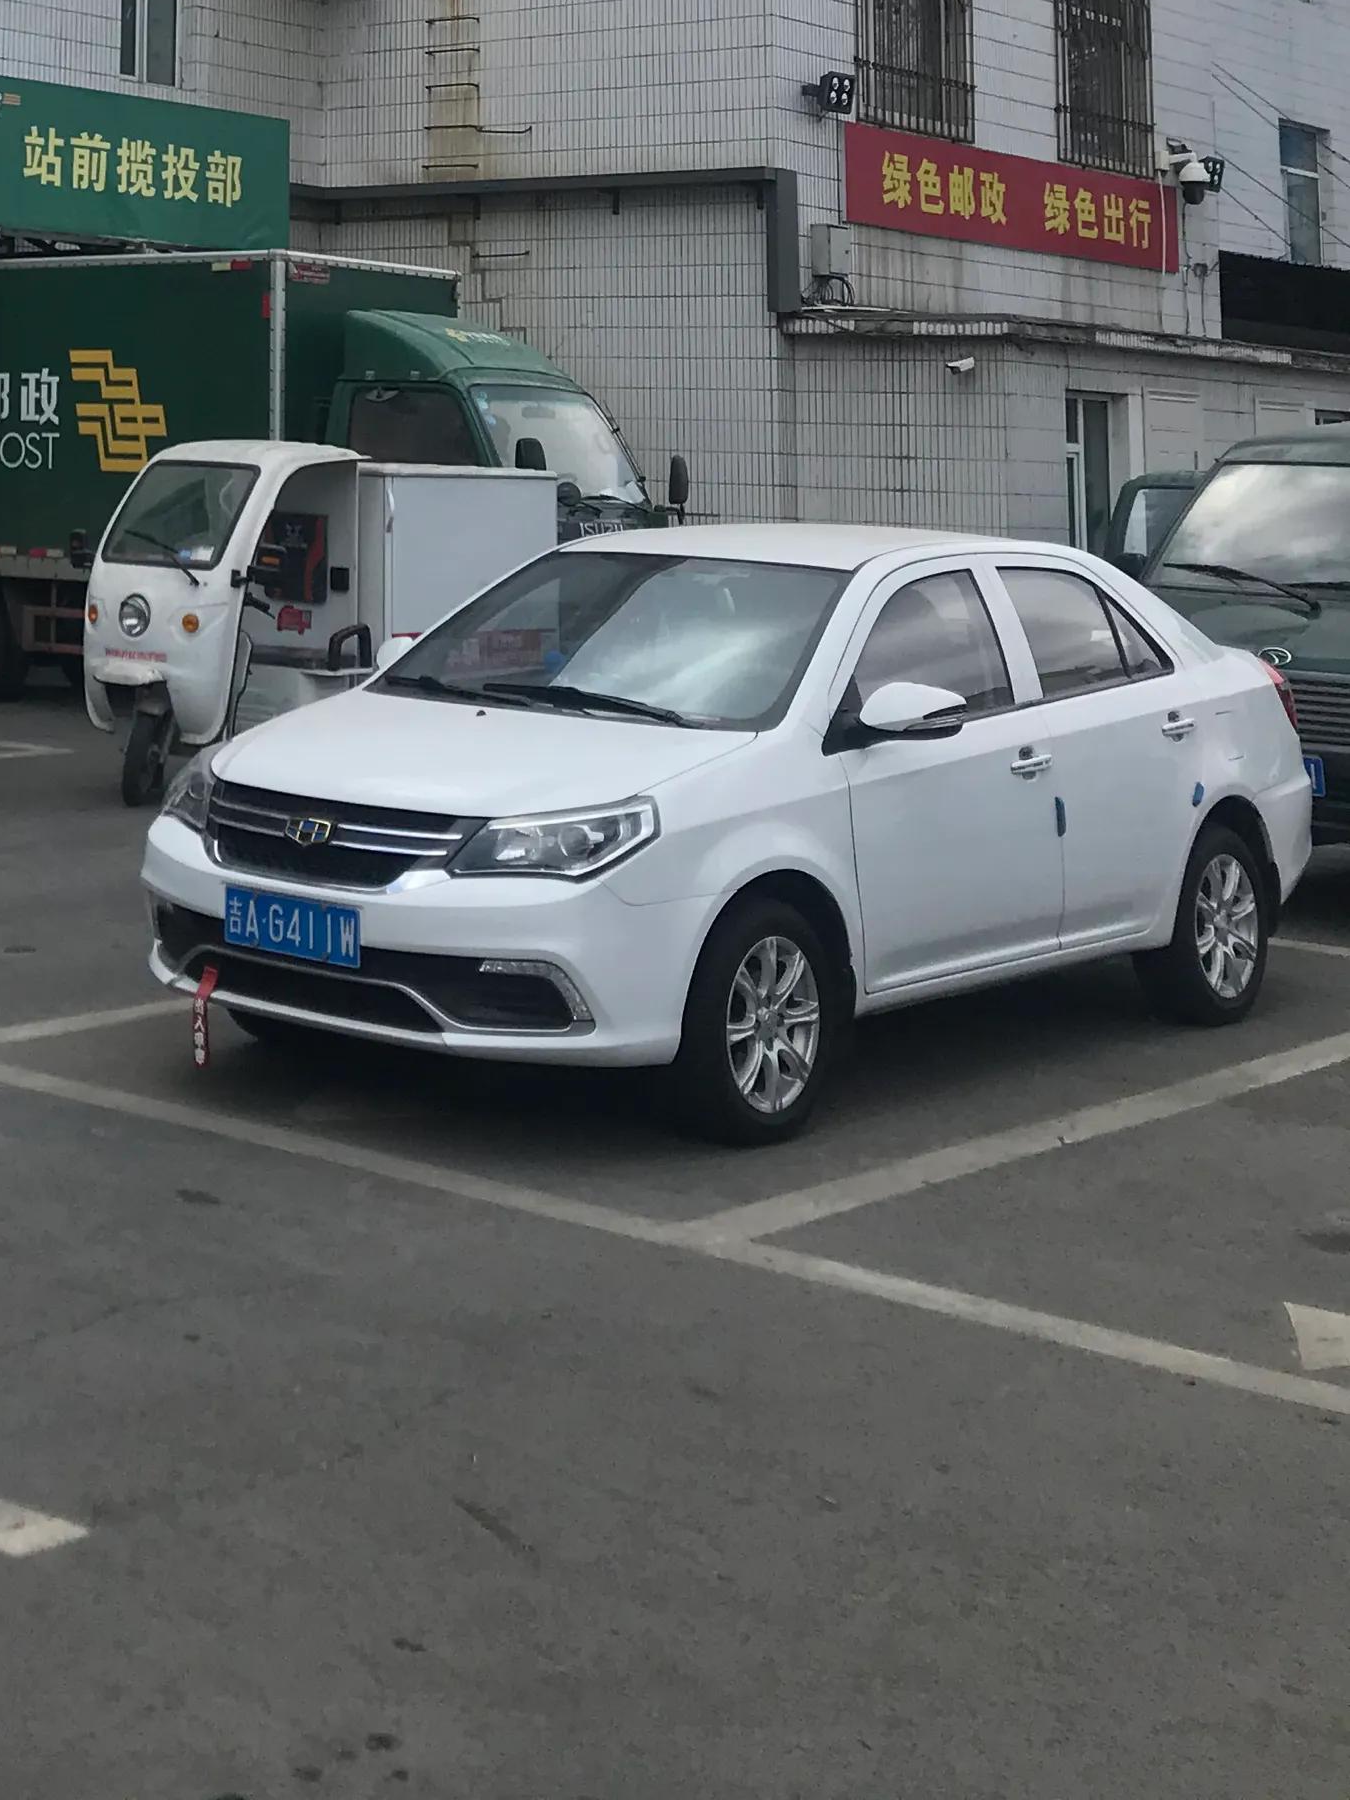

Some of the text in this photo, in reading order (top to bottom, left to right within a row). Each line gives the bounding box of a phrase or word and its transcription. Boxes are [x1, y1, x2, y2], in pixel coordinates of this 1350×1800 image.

[23, 125, 243, 208] 站前揽投部
[881, 150, 1152, 250] 绿色邮政 绿色出行
